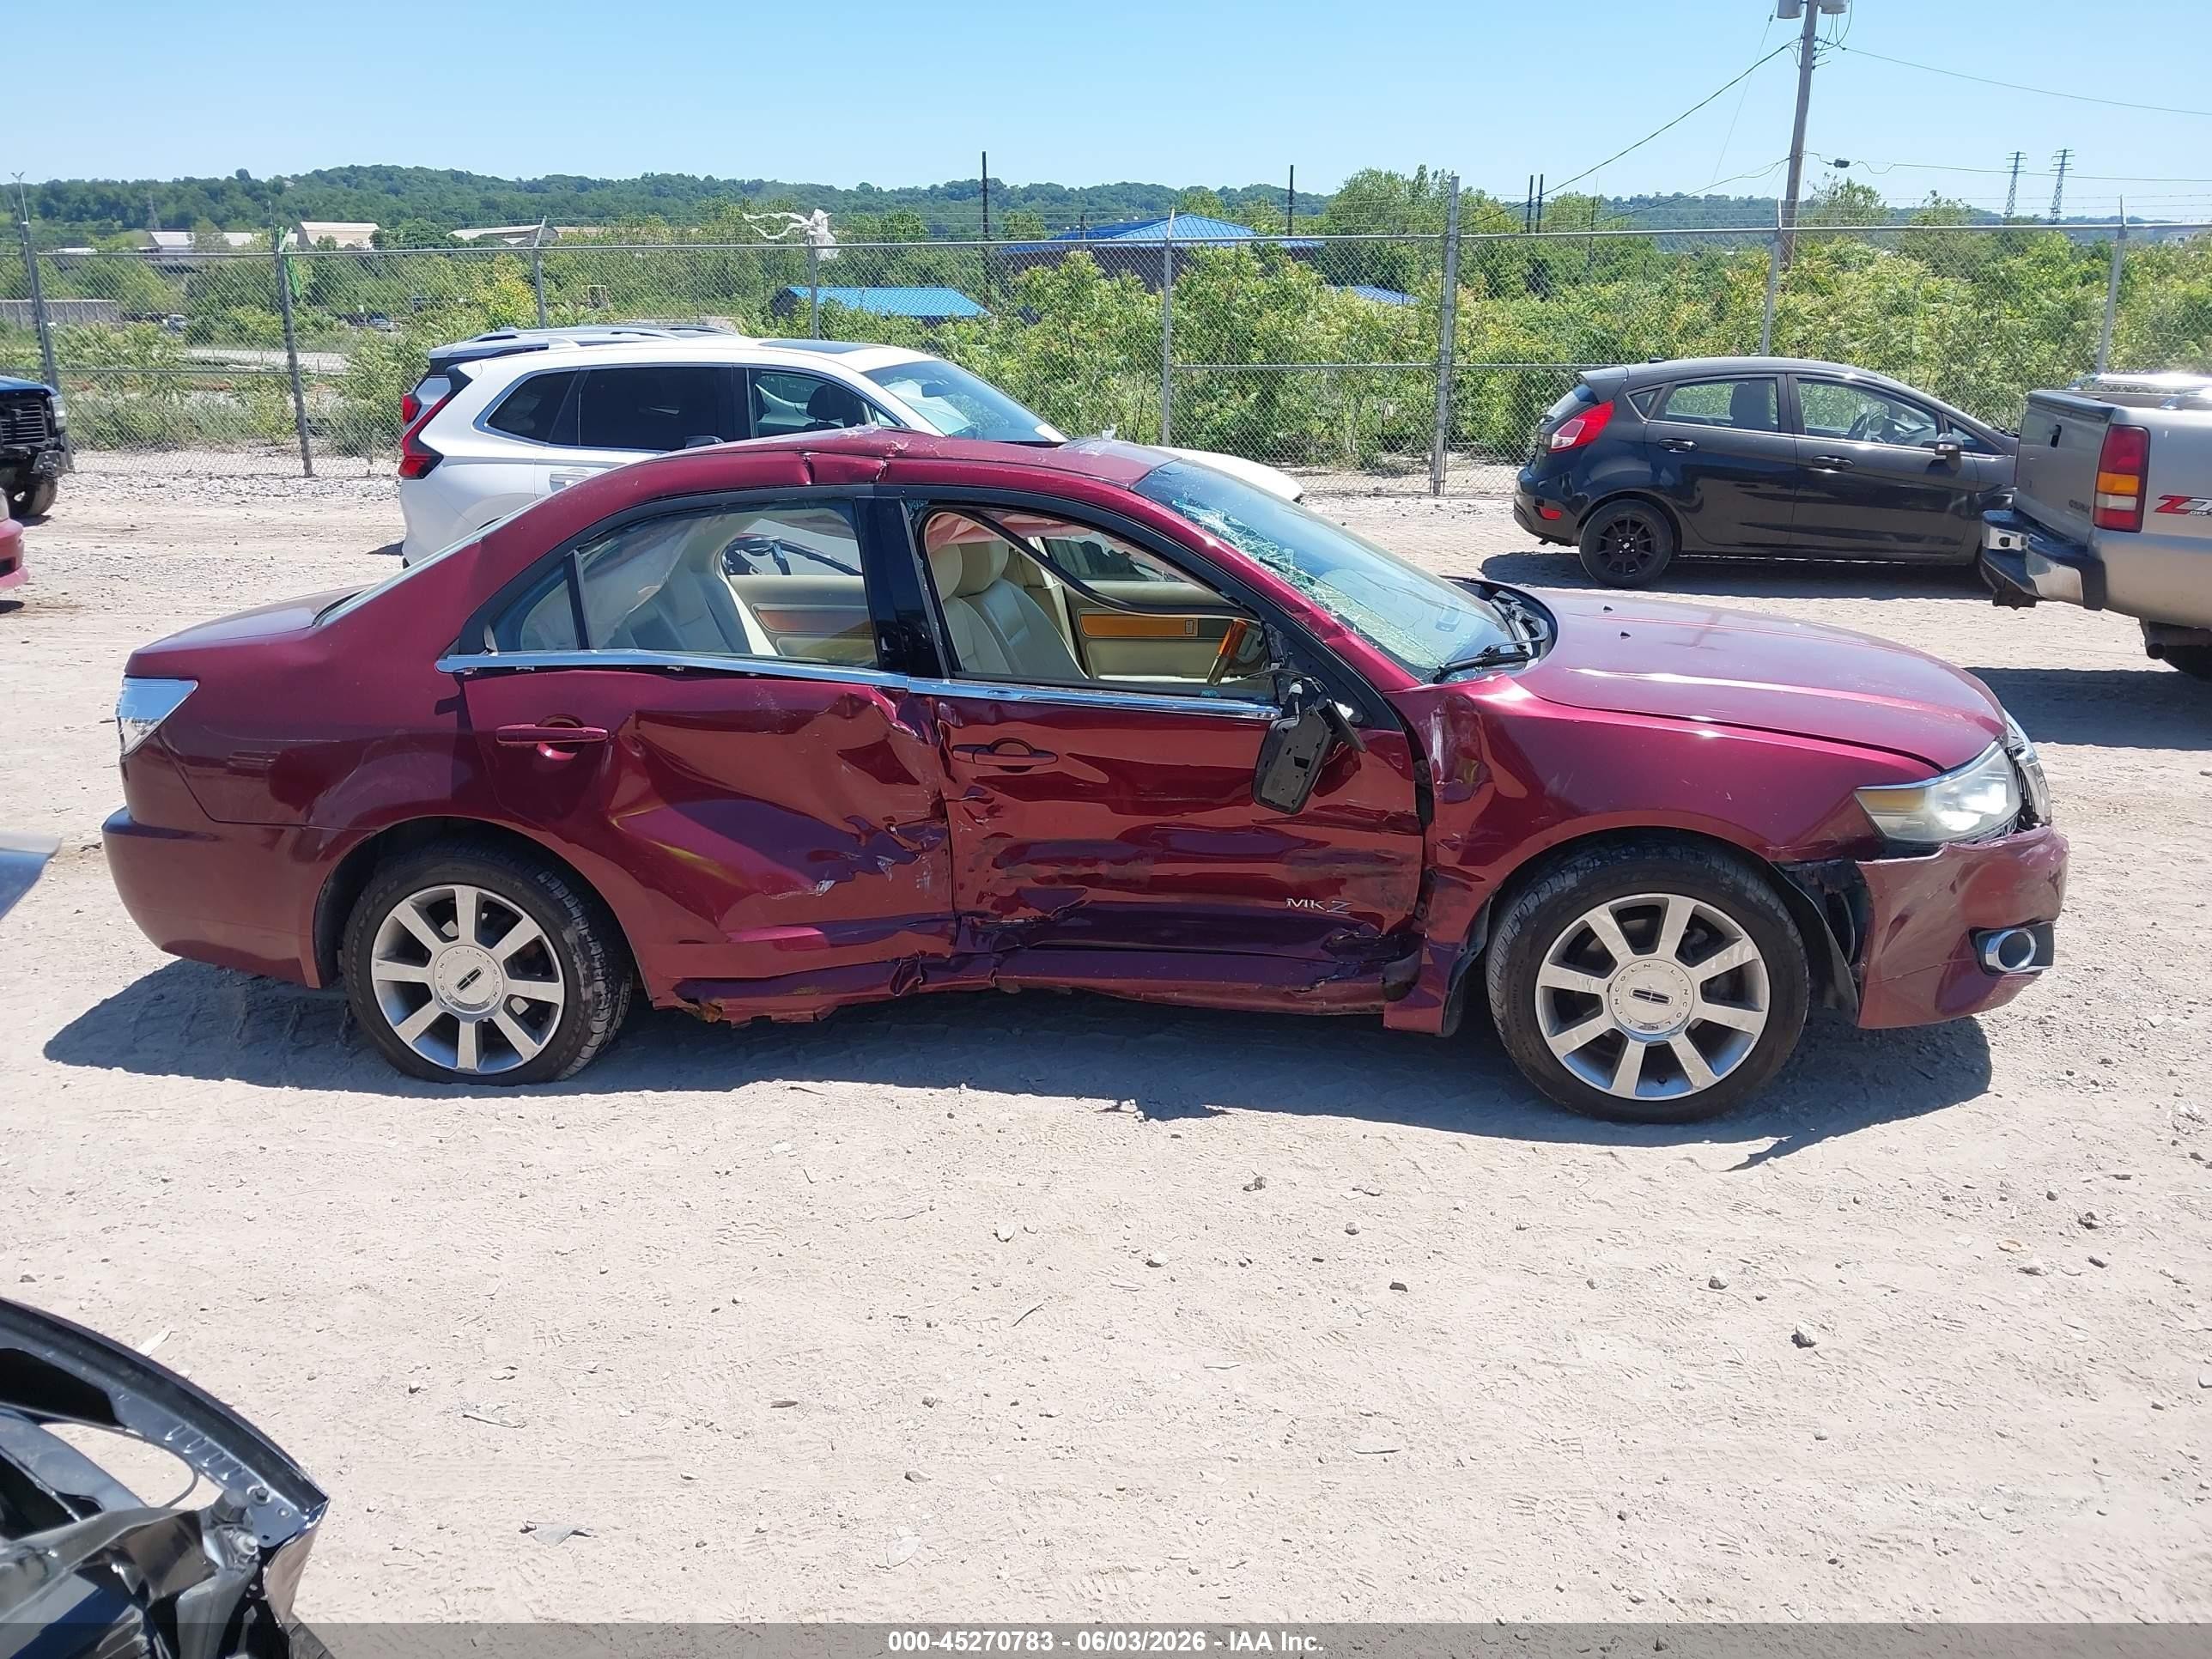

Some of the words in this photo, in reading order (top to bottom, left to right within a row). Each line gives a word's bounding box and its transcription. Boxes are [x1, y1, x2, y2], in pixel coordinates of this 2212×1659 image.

[2154, 495, 2212, 515] Z7
[1285, 898, 1353, 915] MKZ
[1613, 963, 1651, 1024] LINCOLN
[1651, 969, 1689, 1030] LINCOLN
